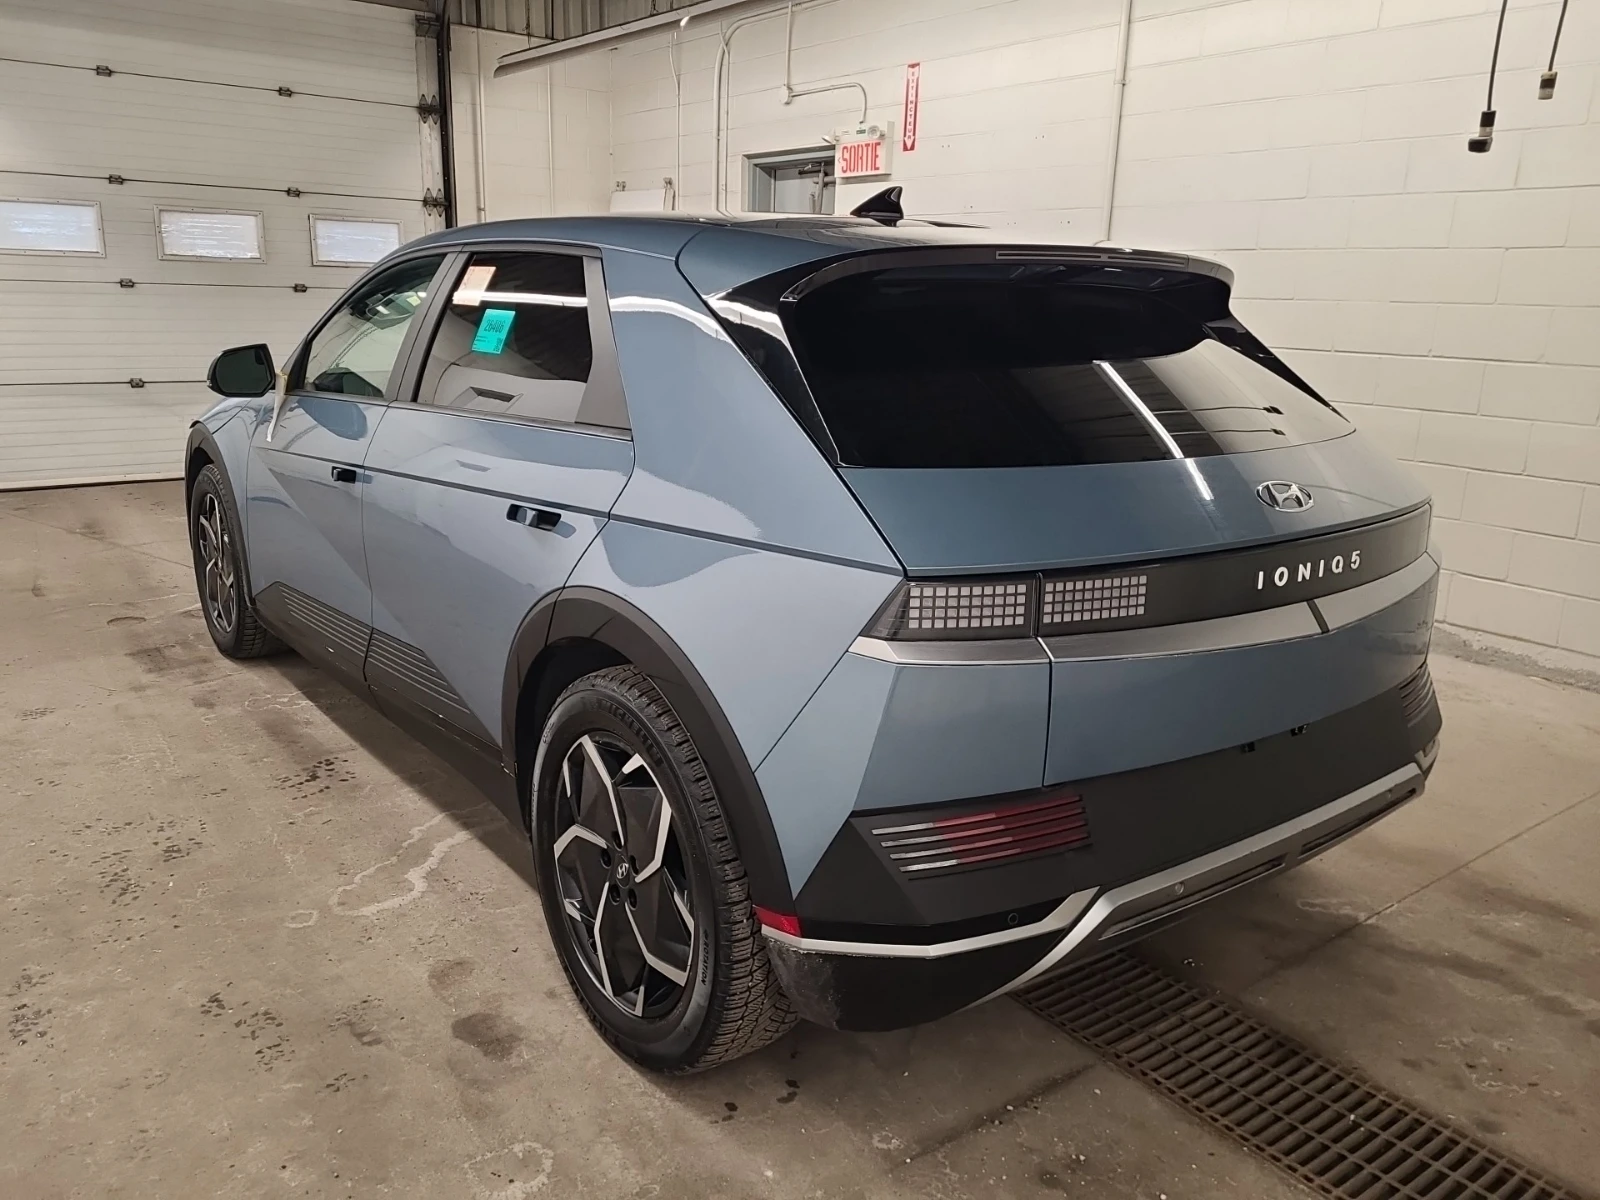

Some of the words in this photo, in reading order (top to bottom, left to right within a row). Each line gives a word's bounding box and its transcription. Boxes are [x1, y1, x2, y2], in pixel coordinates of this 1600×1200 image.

[907, 71, 915, 140] EXTINCTEUR
[842, 141, 881, 173] SORTIE
[1257, 555, 1344, 590] IONIQ
[1350, 550, 1361, 570] 5
[700, 941, 710, 986] ROTATION
